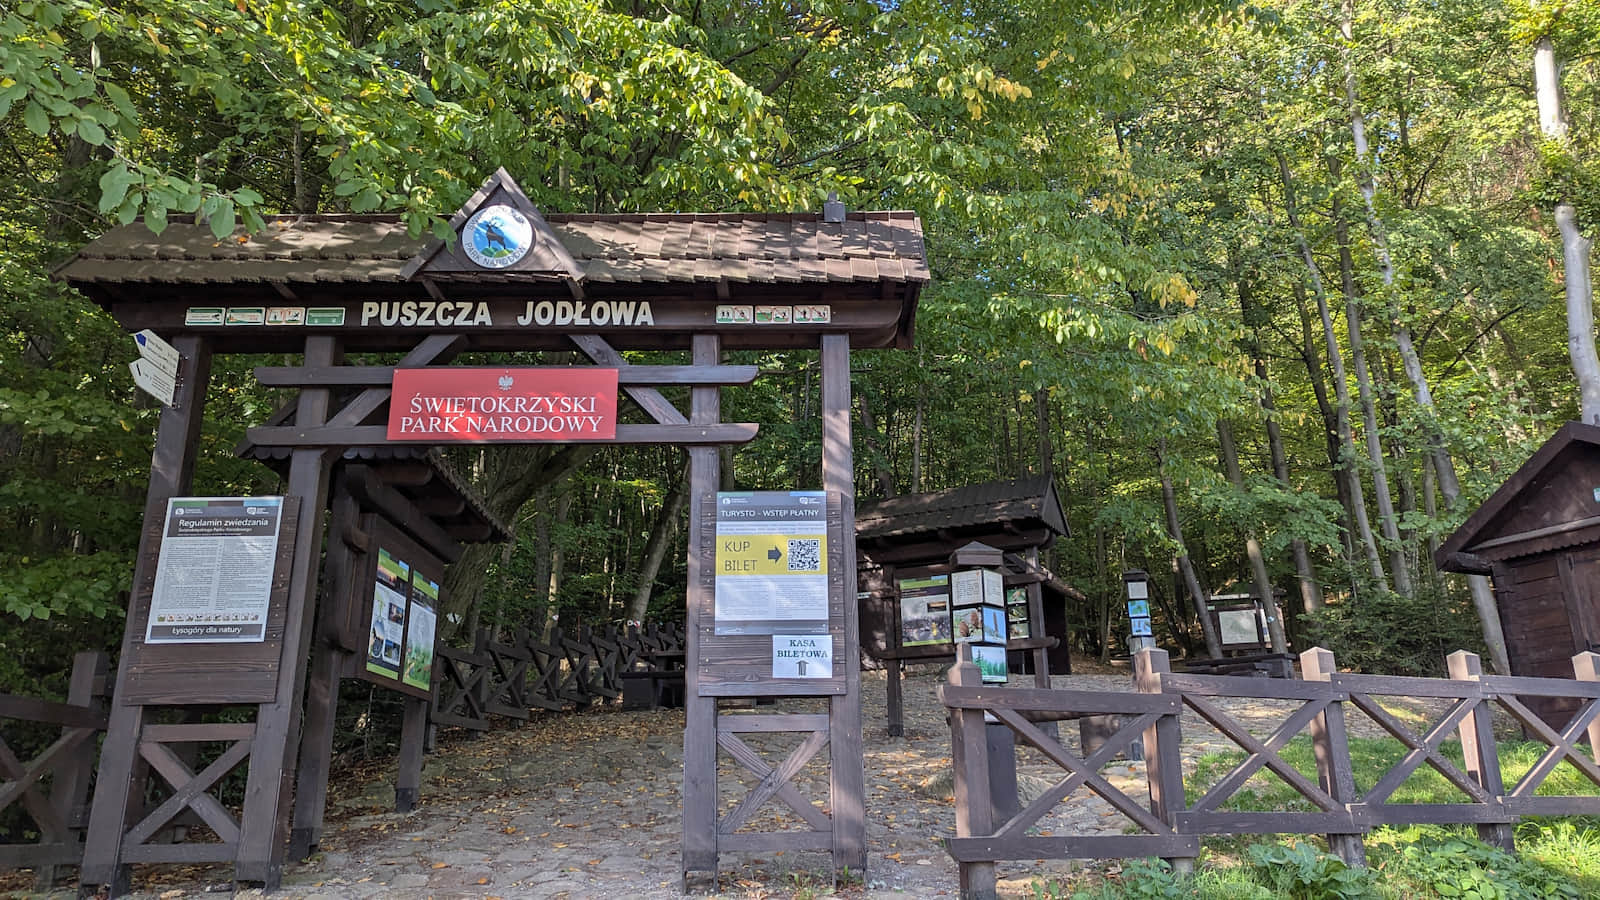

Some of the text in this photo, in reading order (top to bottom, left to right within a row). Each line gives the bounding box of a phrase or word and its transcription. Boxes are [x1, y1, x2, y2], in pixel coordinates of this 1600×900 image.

[464, 242, 482, 262] PARK
[361, 301, 655, 327] PUSZCZA JODŁOWA
[410, 392, 596, 418] ŚWIĘTOKRZYSKI
[400, 415, 604, 433] PARK NARODOWY
[762, 509, 788, 518] WSTĘP
[789, 509, 820, 517] PŁATNY
[178, 517, 269, 528] Regulamin zwiedzania
[724, 541, 751, 553] KUP
[724, 559, 758, 572] BILET
[172, 625, 242, 635] Łysogóry dla natury
[789, 639, 816, 647] KASA
[777, 650, 828, 658] BILETOWA
